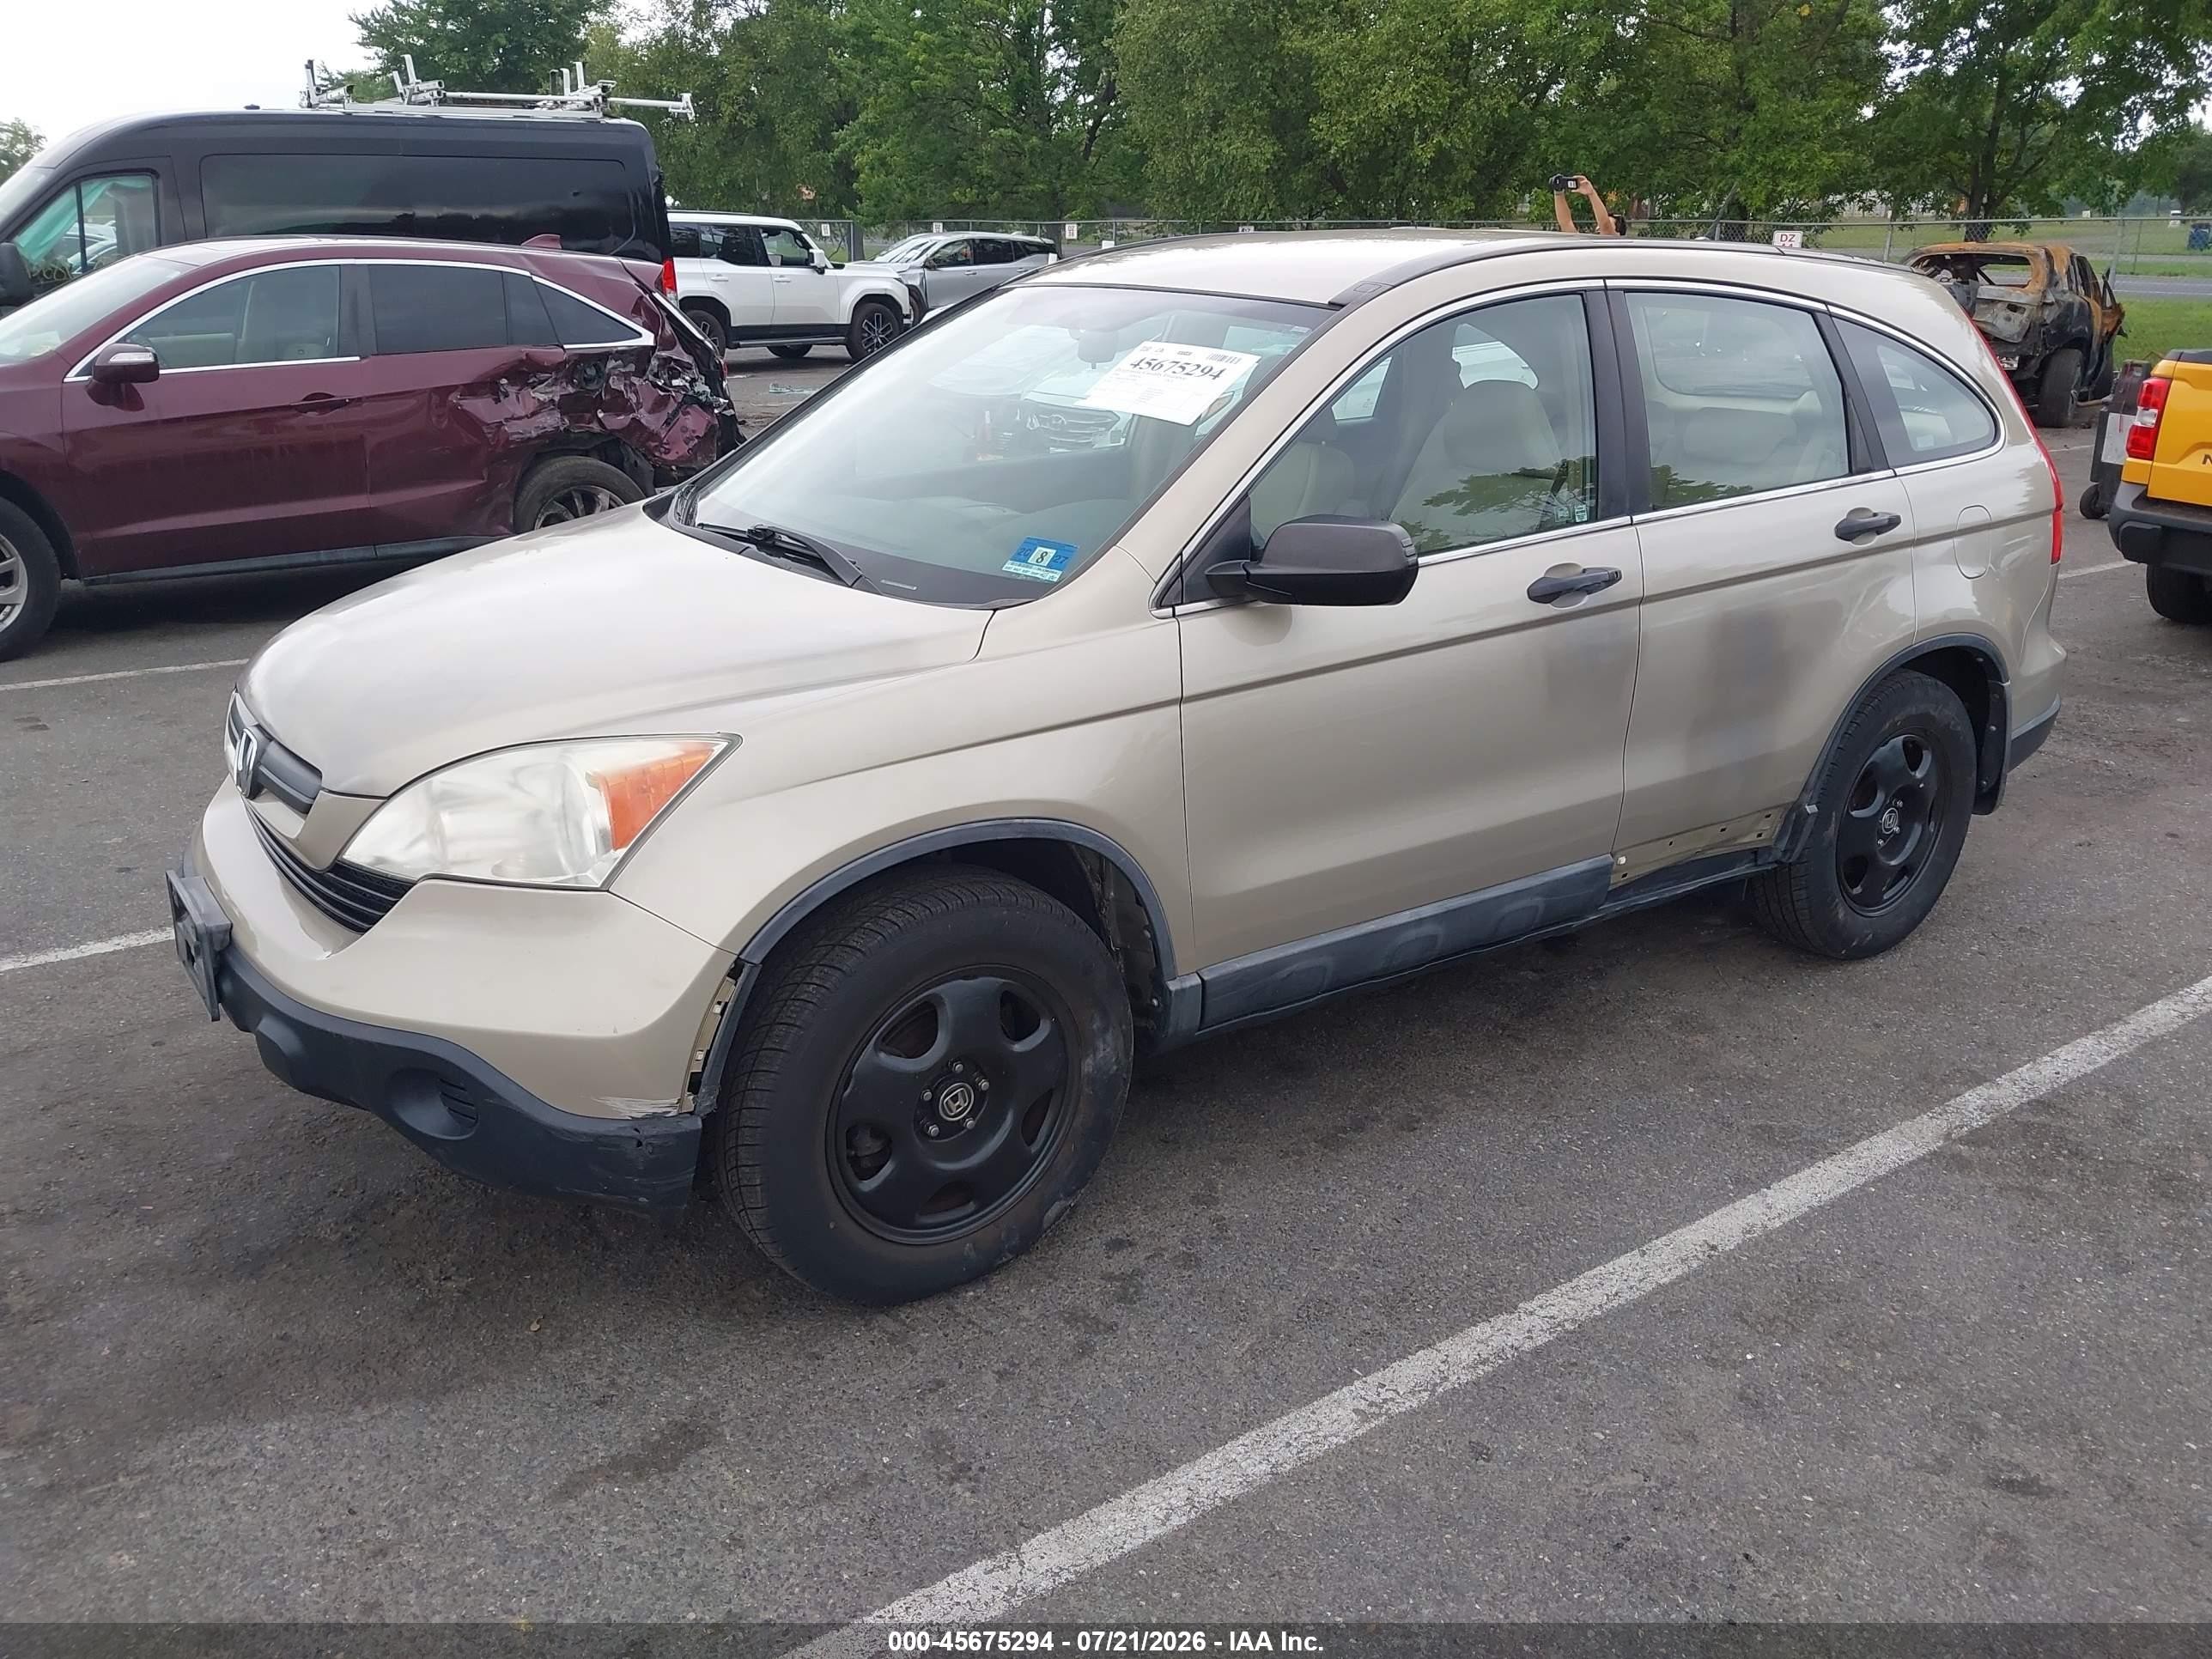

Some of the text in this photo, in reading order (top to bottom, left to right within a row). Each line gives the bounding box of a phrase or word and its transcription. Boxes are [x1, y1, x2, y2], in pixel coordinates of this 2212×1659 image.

[1779, 234, 1796, 242] DZ
[1130, 357, 1226, 380] 45675294
[1036, 551, 1048, 563] 8
[1053, 555, 1068, 564] 27
